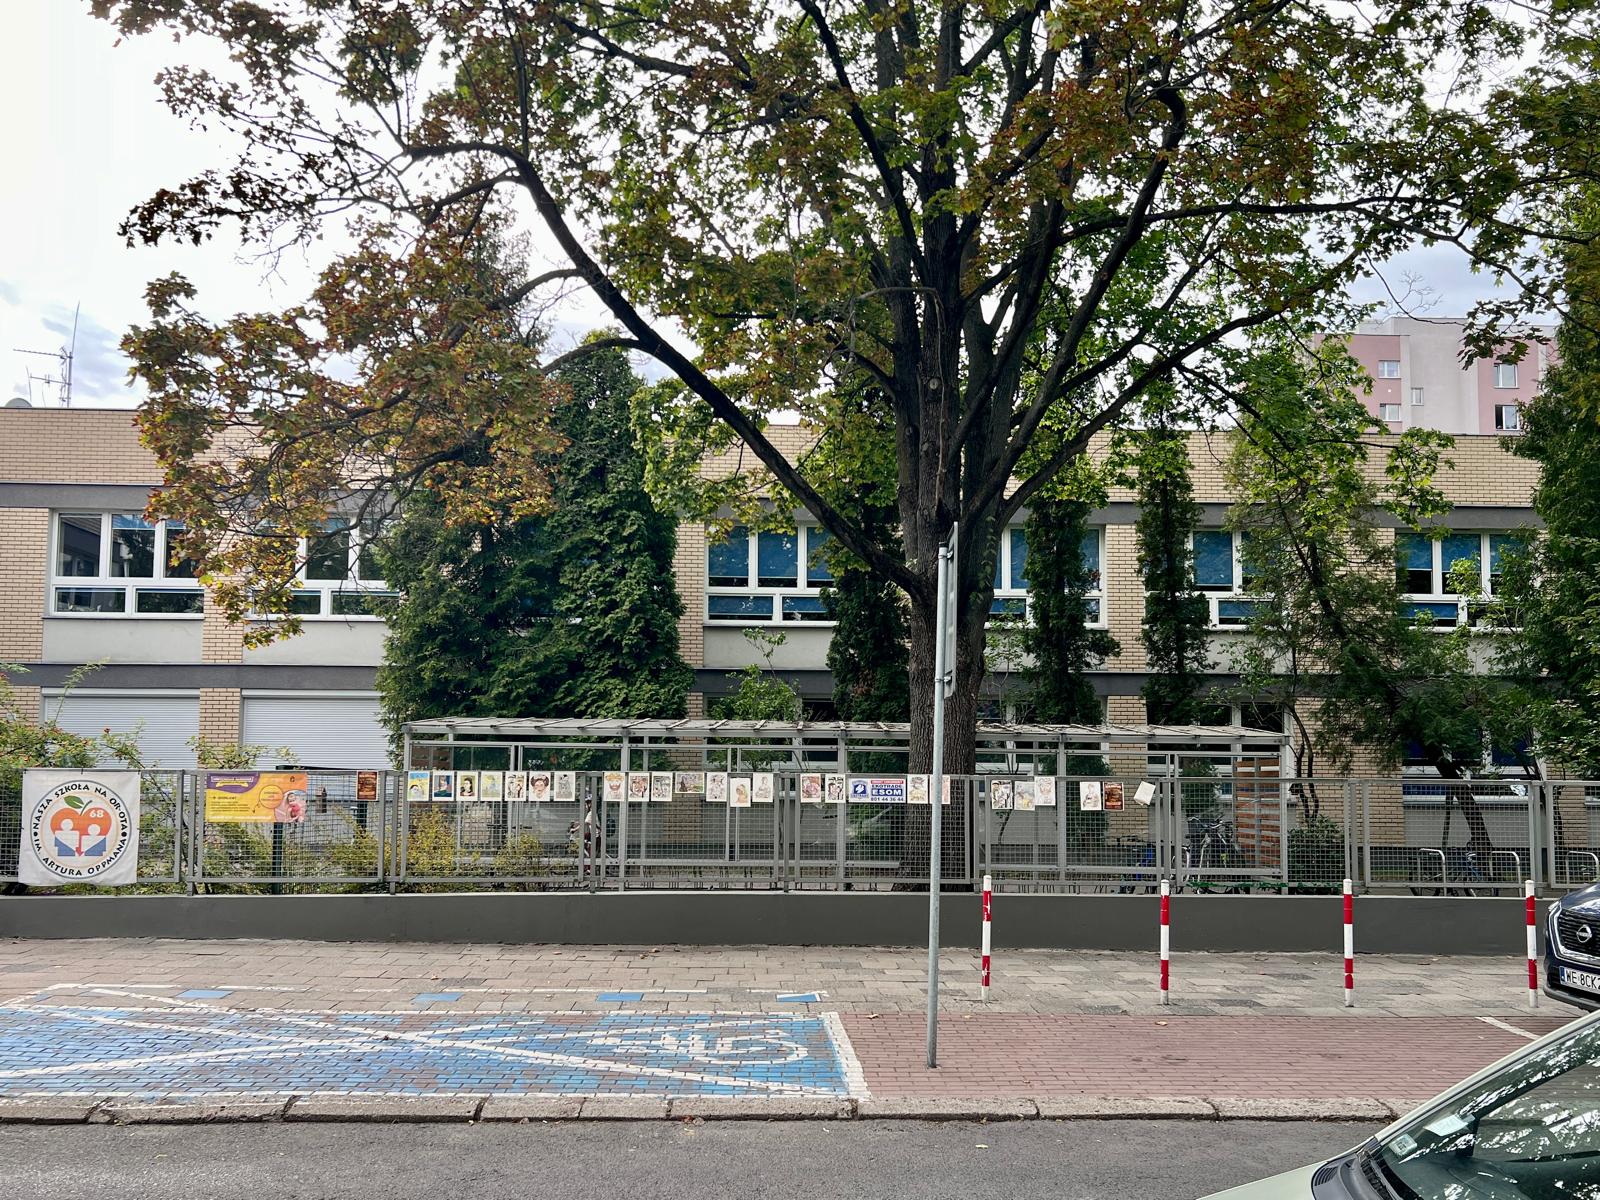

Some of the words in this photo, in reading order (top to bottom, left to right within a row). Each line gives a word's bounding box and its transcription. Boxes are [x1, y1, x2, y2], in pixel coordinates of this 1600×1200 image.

[33, 798, 52, 829] NASZA
[55, 783, 90, 798] SZKOŁA
[94, 787, 107, 797] NA
[89, 809, 104, 818] 68
[43, 857, 82, 876] ARTURA
[87, 838, 127, 874] OPPMANA
[1566, 970, 1577, 984] WE
